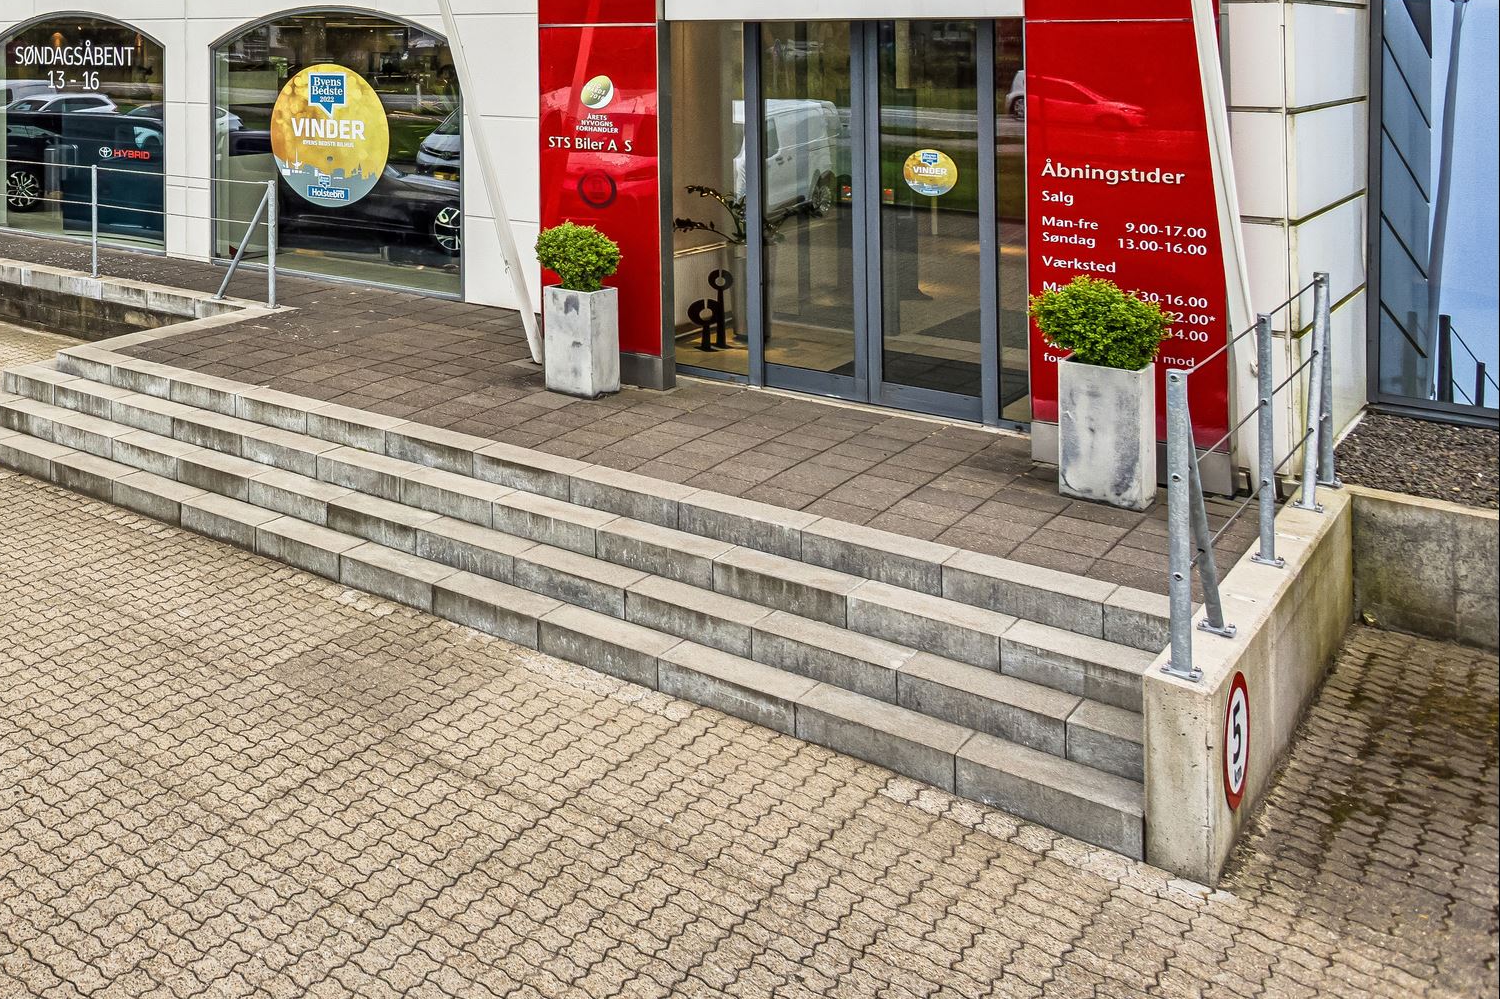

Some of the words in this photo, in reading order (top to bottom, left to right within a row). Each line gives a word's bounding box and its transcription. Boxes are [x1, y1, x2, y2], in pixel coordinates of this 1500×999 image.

[14, 40, 135, 67] SØNDAGSÅBENT
[47, 70, 65, 89] 13
[82, 71, 100, 90] 16
[313, 76, 342, 88] Byens
[311, 85, 343, 96] Bedste
[291, 117, 366, 141] VINDER
[576, 125, 618, 133] FORHANDLER
[548, 136, 571, 149] STS
[575, 137, 605, 150] Biler
[113, 148, 150, 160] HYBRID
[912, 166, 948, 175] VINDER
[1041, 158, 1186, 185] Åbningstider
[312, 188, 345, 199] Holstebro
[1041, 190, 1074, 206] Salg
[1041, 215, 1099, 230] Man-fre
[1125, 222, 1207, 239] 9.00-17.00
[1042, 231, 1096, 249] Søndag
[1117, 238, 1207, 256] 13.00-16.00
[1041, 255, 1116, 273] Værksted
[1127, 290, 1208, 308] 730-16.00
[1163, 356, 1195, 367] mod
[1233, 701, 1241, 764] 5
